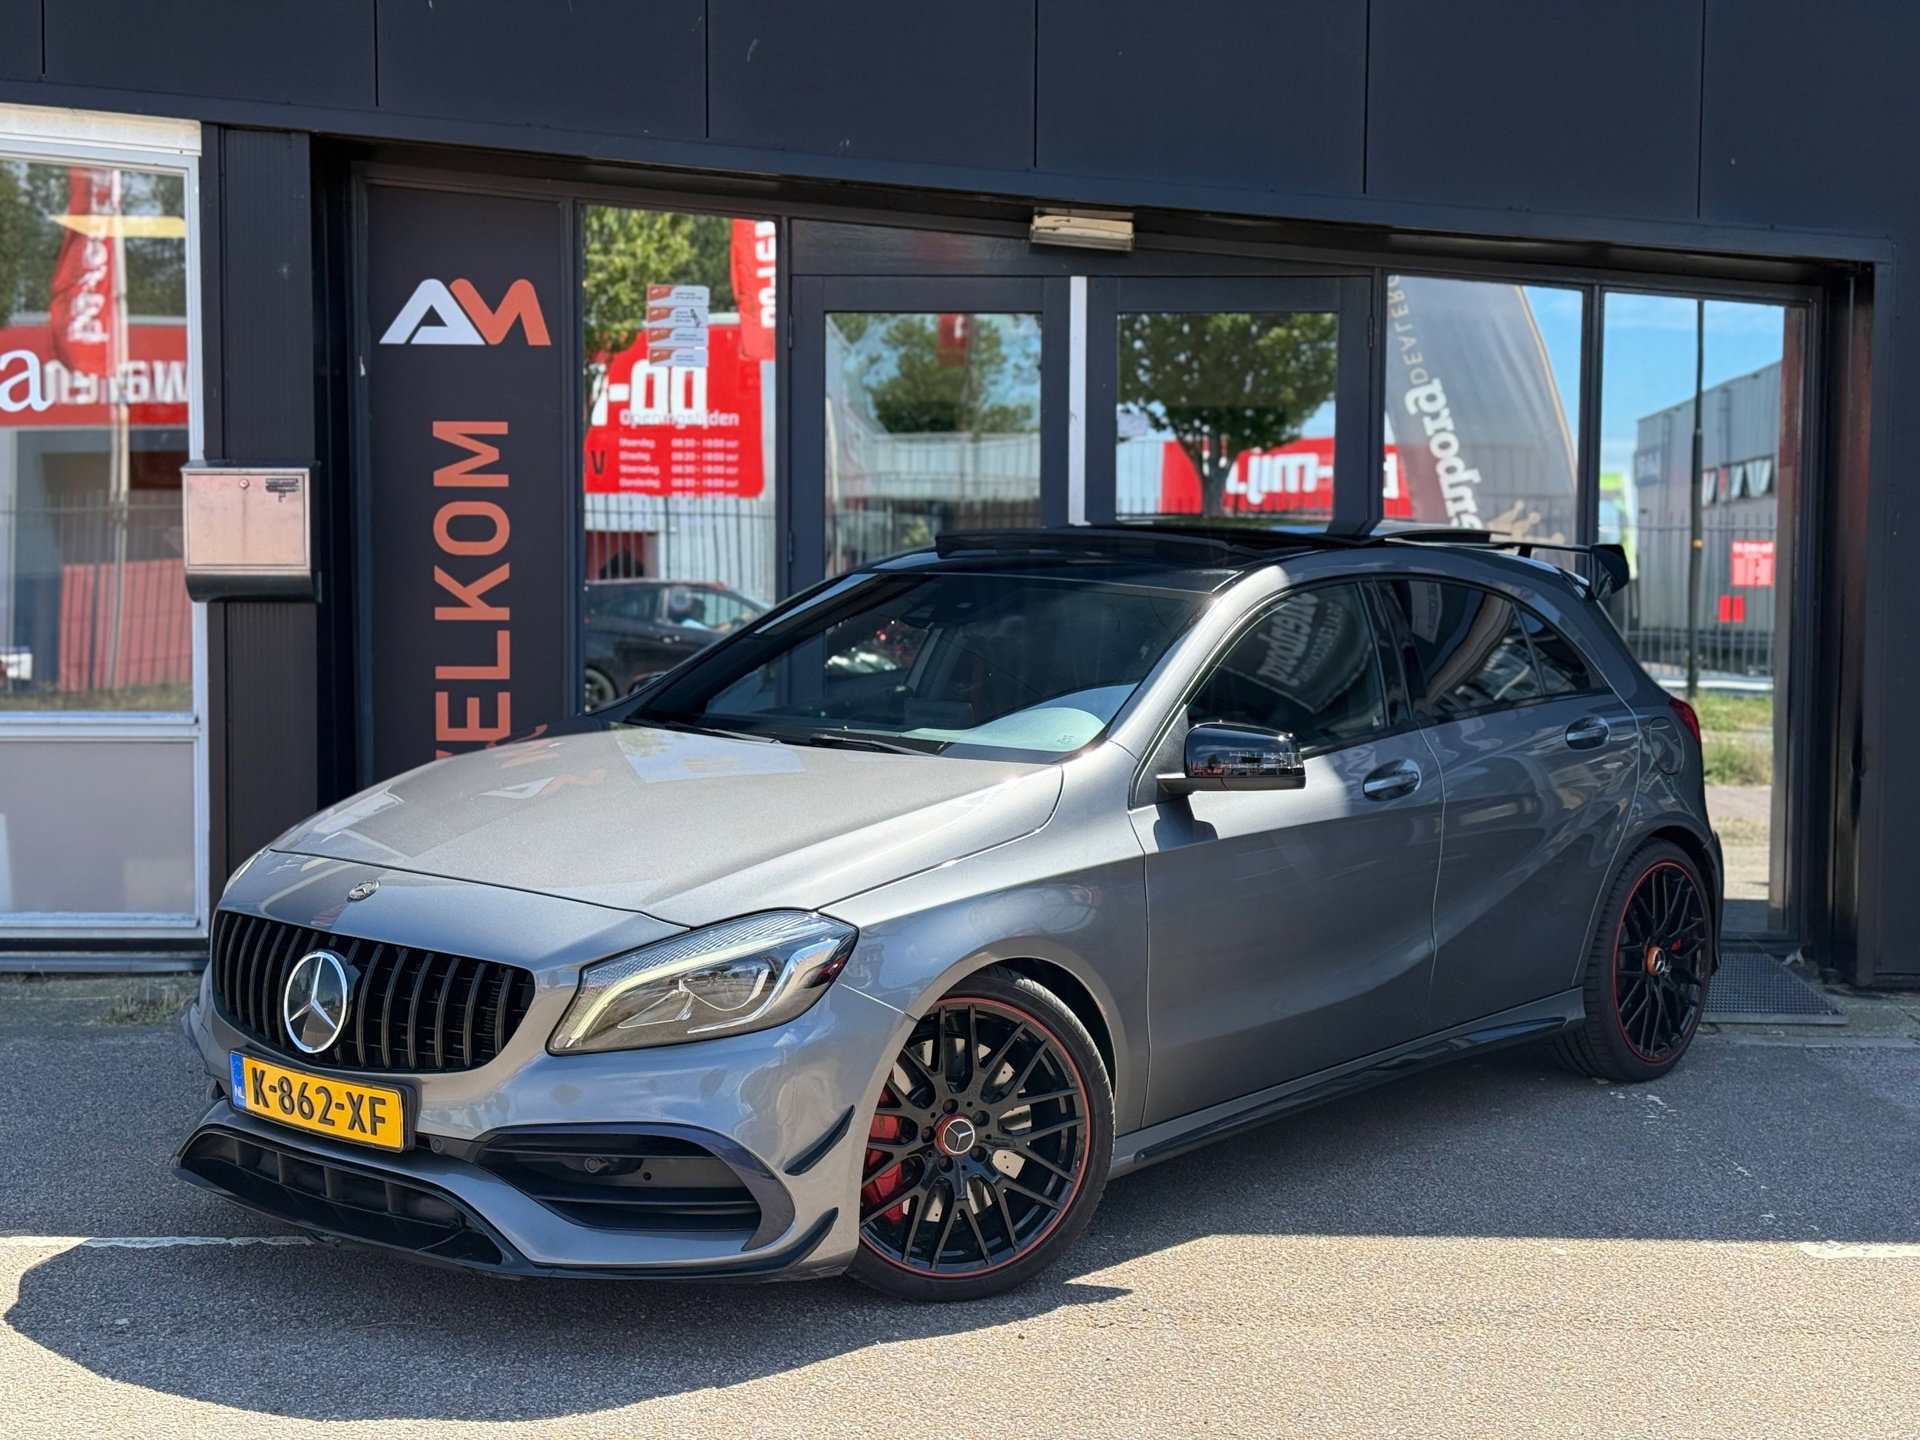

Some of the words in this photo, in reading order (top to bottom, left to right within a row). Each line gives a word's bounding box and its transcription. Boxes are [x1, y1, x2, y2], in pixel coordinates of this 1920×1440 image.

[378, 278, 552, 346] AM
[433, 421, 511, 760] ELKOM
[234, 1086, 245, 1099] NL
[251, 1067, 386, 1136] K-862-XF
